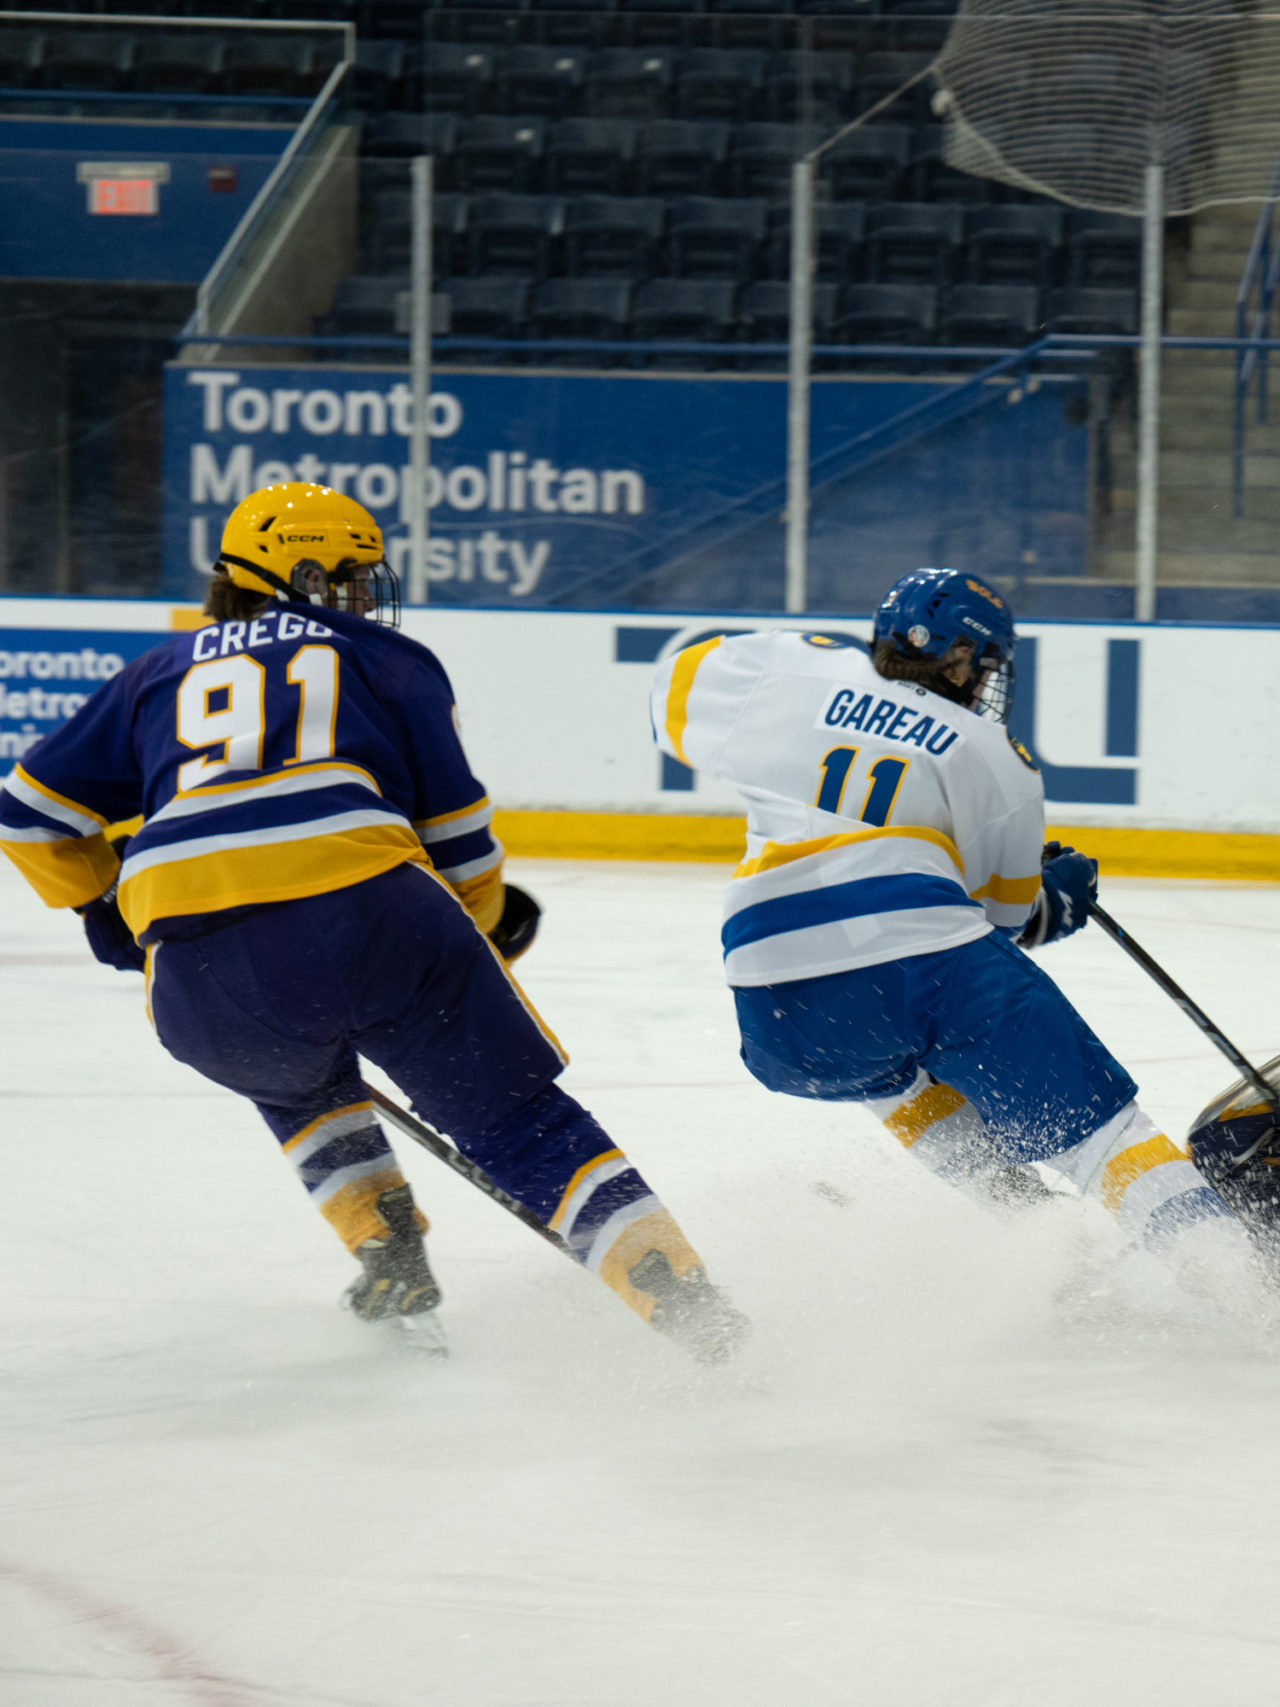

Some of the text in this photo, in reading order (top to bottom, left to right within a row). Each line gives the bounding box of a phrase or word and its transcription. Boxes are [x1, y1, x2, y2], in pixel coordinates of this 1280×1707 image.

[187, 371, 463, 439] Toronto
[176, 643, 339, 793] 91
[824, 688, 960, 756] GAREAU
[812, 744, 911, 828] 11
